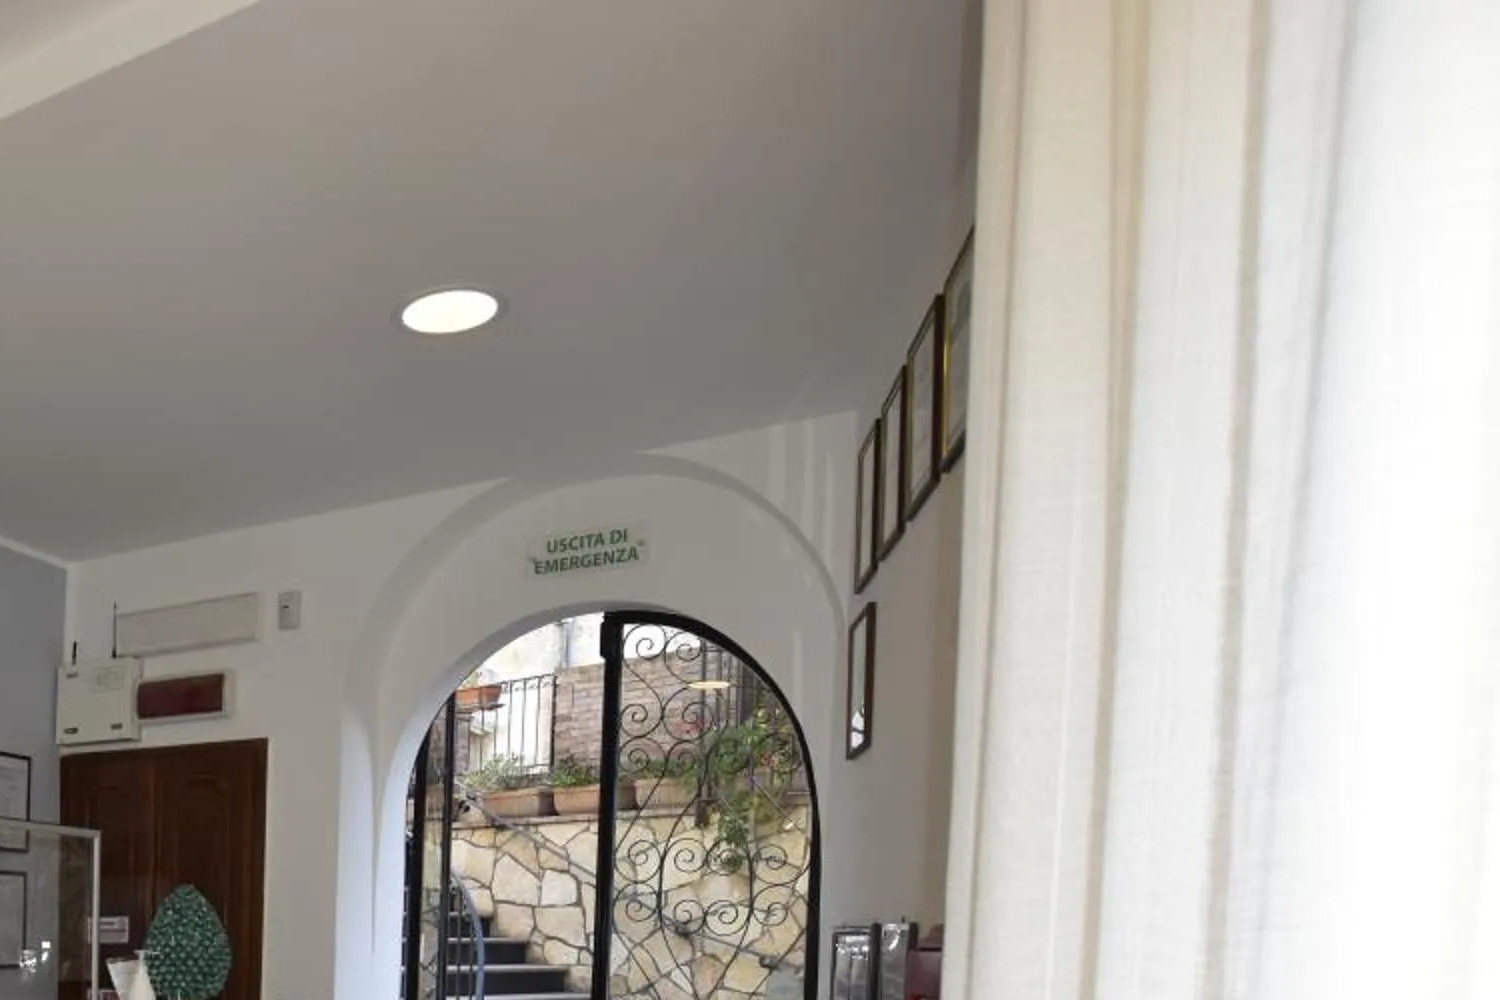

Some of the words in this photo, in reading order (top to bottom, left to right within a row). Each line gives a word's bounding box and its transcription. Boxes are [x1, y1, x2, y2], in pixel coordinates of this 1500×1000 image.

[546, 532, 605, 553] USCITA
[610, 528, 628, 545] DI
[534, 546, 639, 574] EMERGENZA
